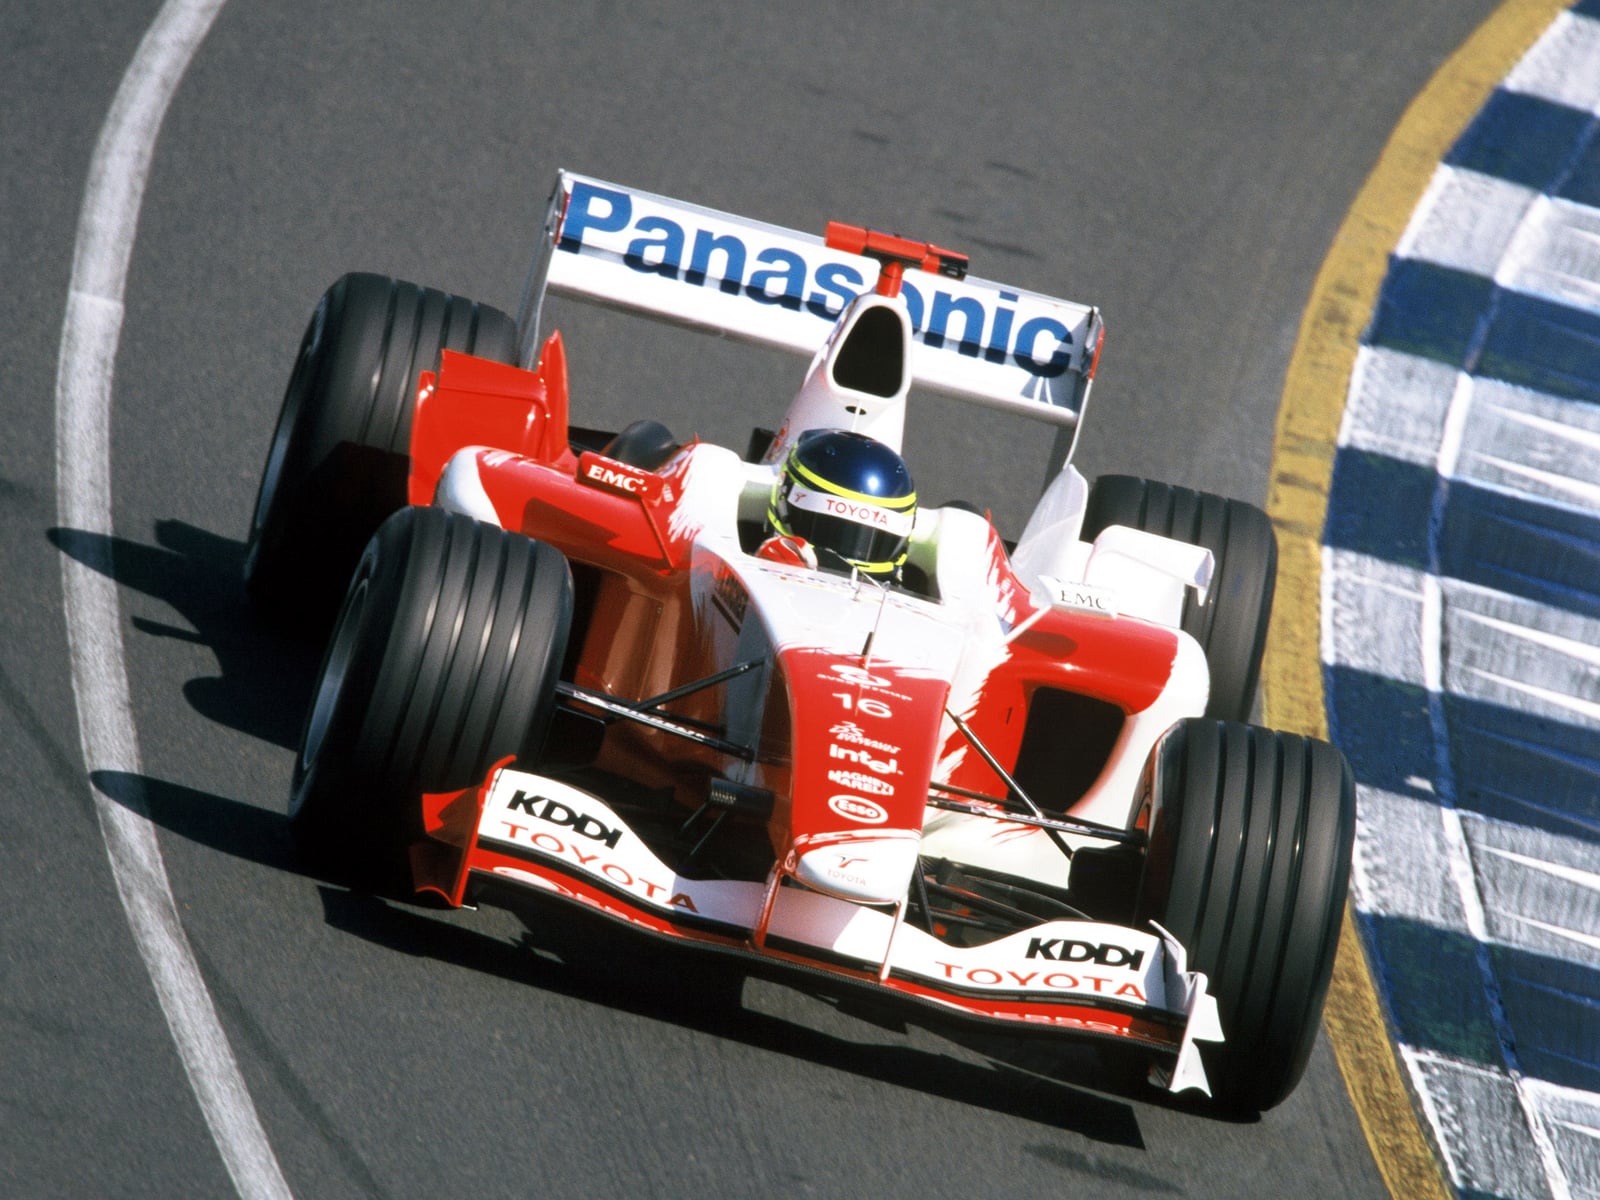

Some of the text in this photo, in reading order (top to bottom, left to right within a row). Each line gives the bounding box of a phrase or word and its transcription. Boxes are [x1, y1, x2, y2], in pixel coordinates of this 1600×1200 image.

[827, 499, 888, 526] TOYOTA
[832, 693, 893, 719] 16
[507, 789, 622, 850] KDDI
[838, 799, 879, 818] Esso
[501, 821, 699, 914] TOYOTA
[827, 867, 867, 887] TOYOTA
[1025, 937, 1144, 972] KDDI
[935, 961, 1148, 1003] TOYOTA
